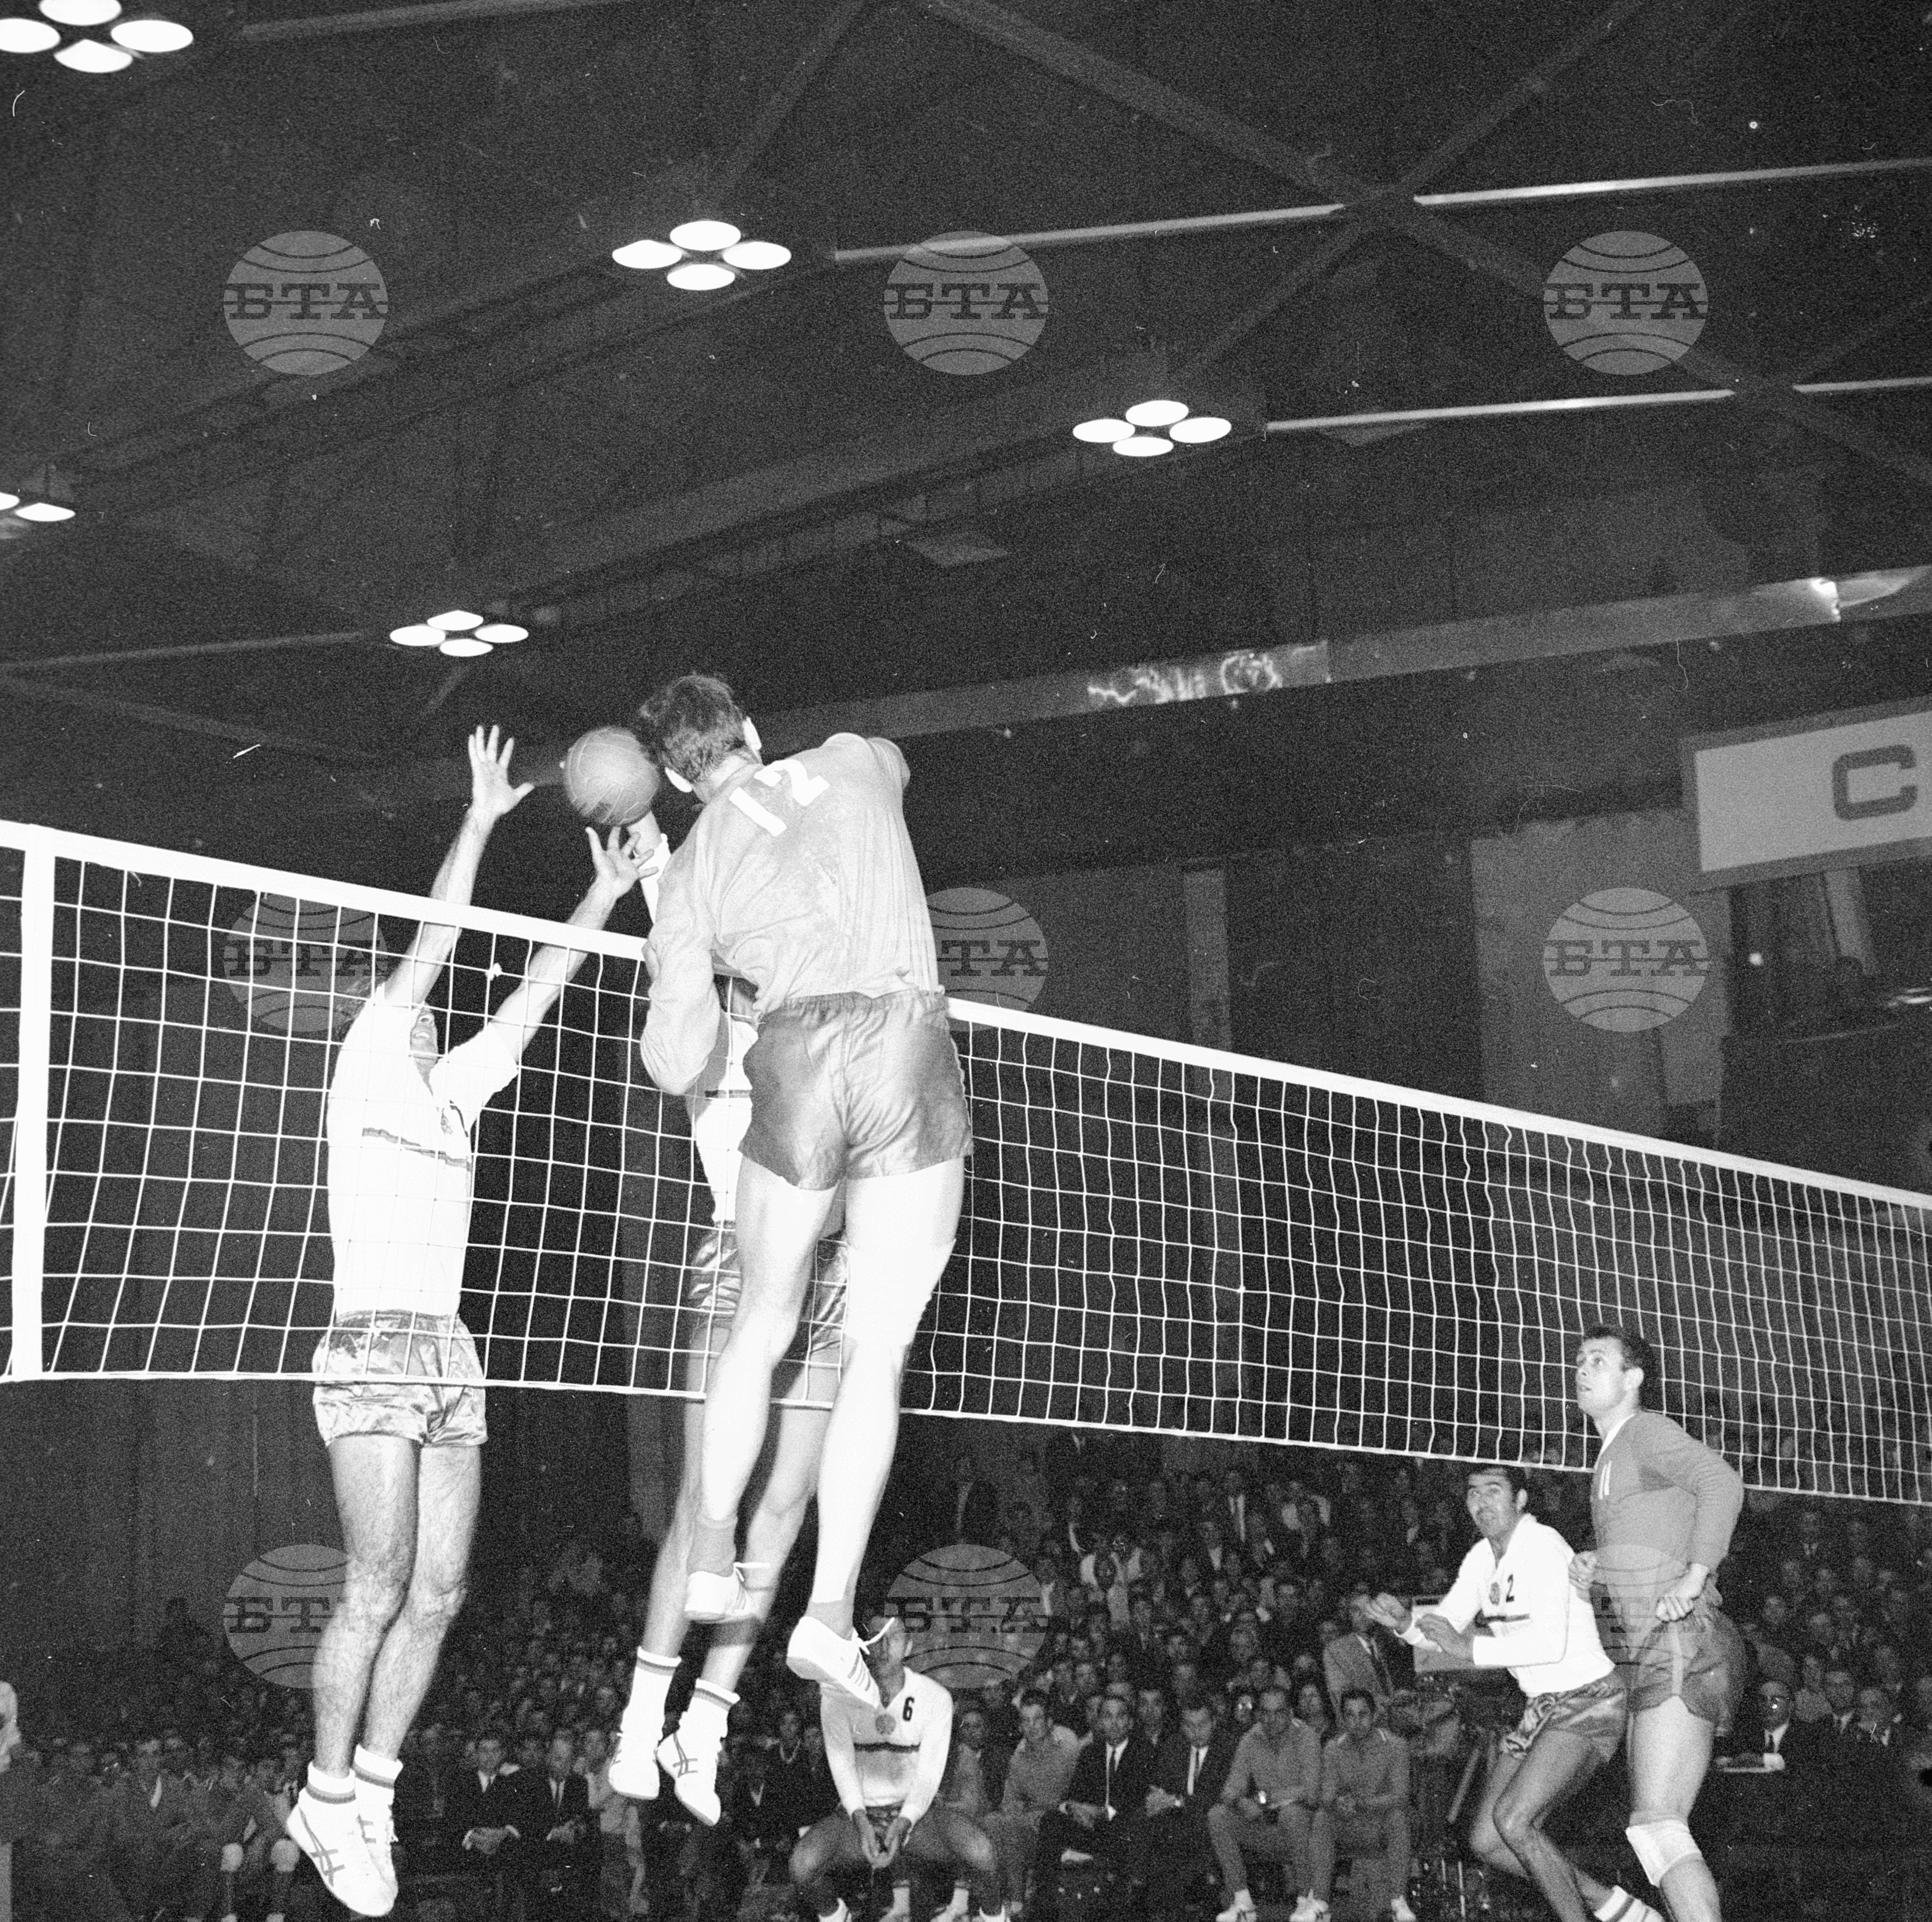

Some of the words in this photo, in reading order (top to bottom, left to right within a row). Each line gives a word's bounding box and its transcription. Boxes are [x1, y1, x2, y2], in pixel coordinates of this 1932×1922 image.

[728, 759, 831, 837] 12
[1598, 1460, 1612, 1500] 11
[1506, 1574, 1515, 1603] 2
[902, 1696, 915, 1722] 6
